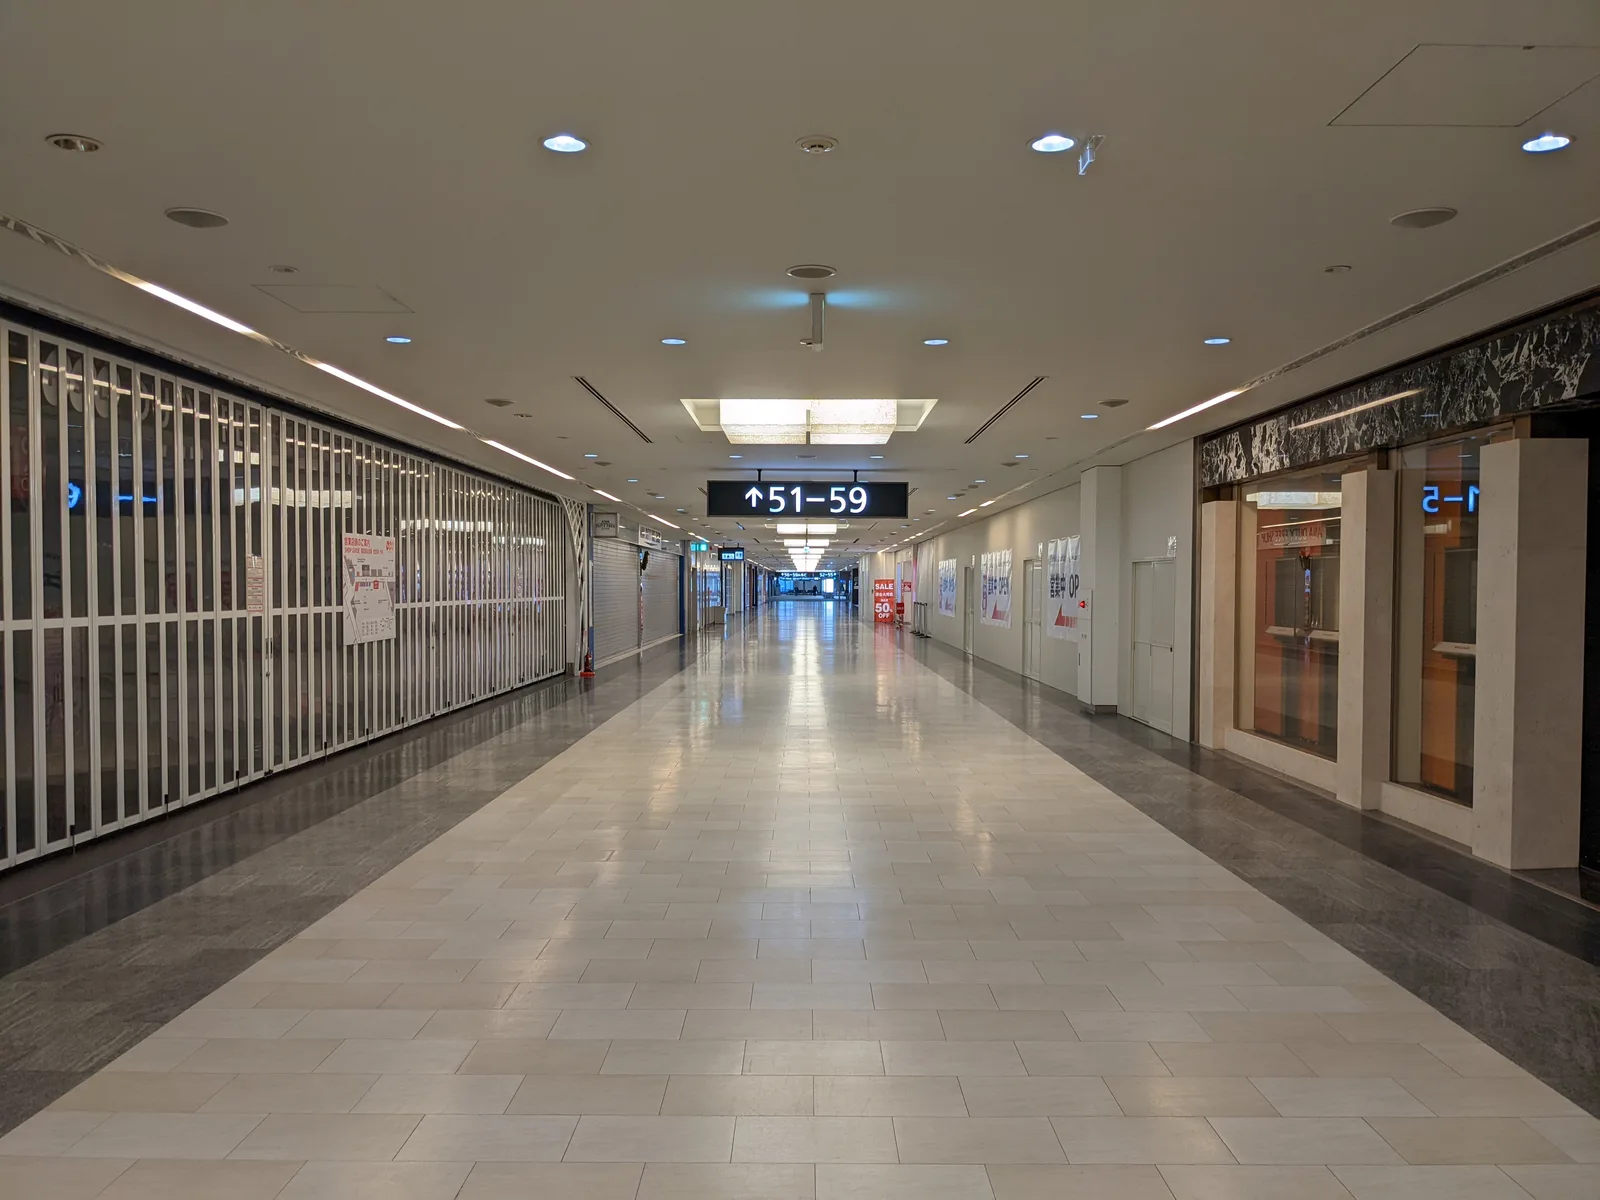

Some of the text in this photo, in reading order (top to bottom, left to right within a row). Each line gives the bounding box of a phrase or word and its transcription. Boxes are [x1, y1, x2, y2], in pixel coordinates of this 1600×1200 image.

[769, 486, 867, 513] 51-59
[1050, 573, 1066, 599] 営業中
